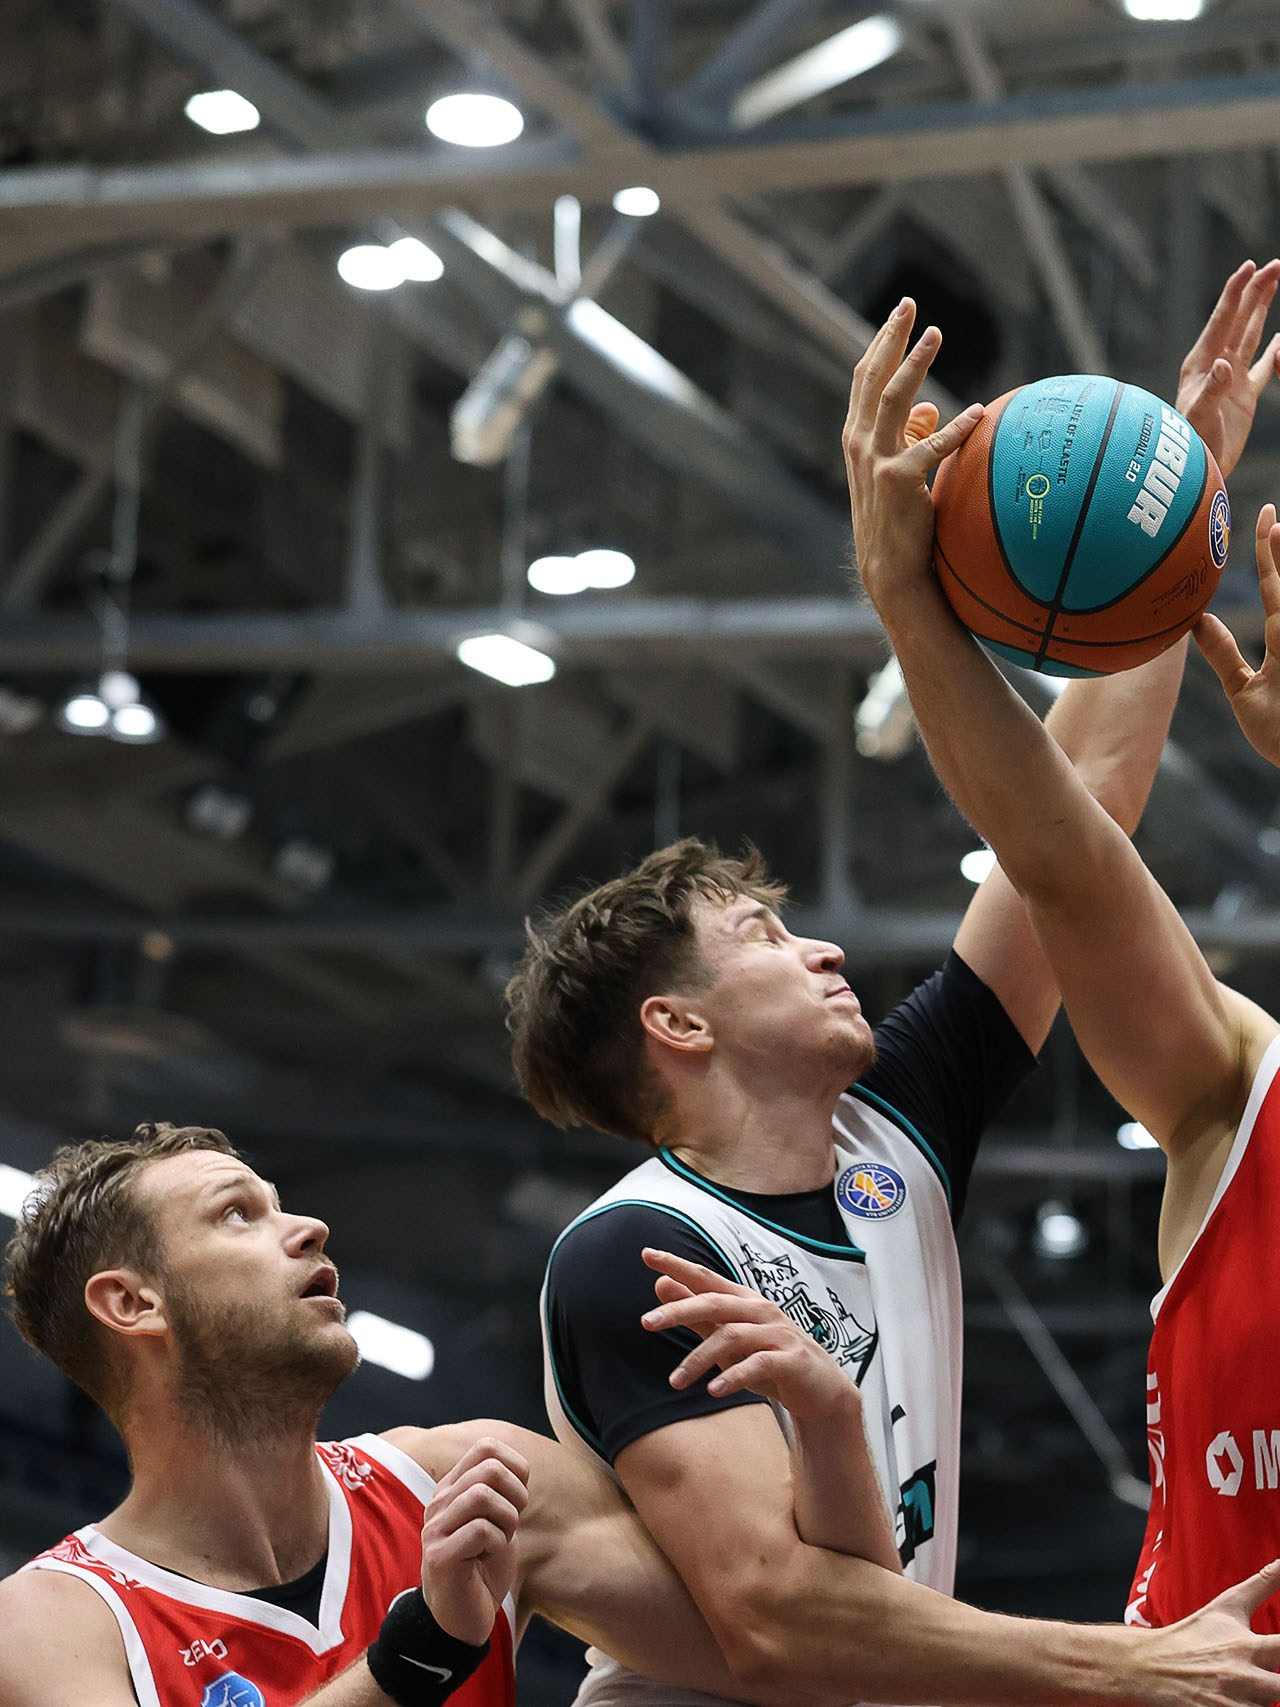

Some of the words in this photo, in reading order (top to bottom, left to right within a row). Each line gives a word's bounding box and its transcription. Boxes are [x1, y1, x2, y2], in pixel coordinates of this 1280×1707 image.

[1070, 404, 1084, 423] LIFE
[1066, 424, 1077, 437] OF
[1057, 439, 1073, 485] PLASTIC
[1125, 460, 1141, 483] 2.0
[1127, 405, 1191, 538] SIBUR
